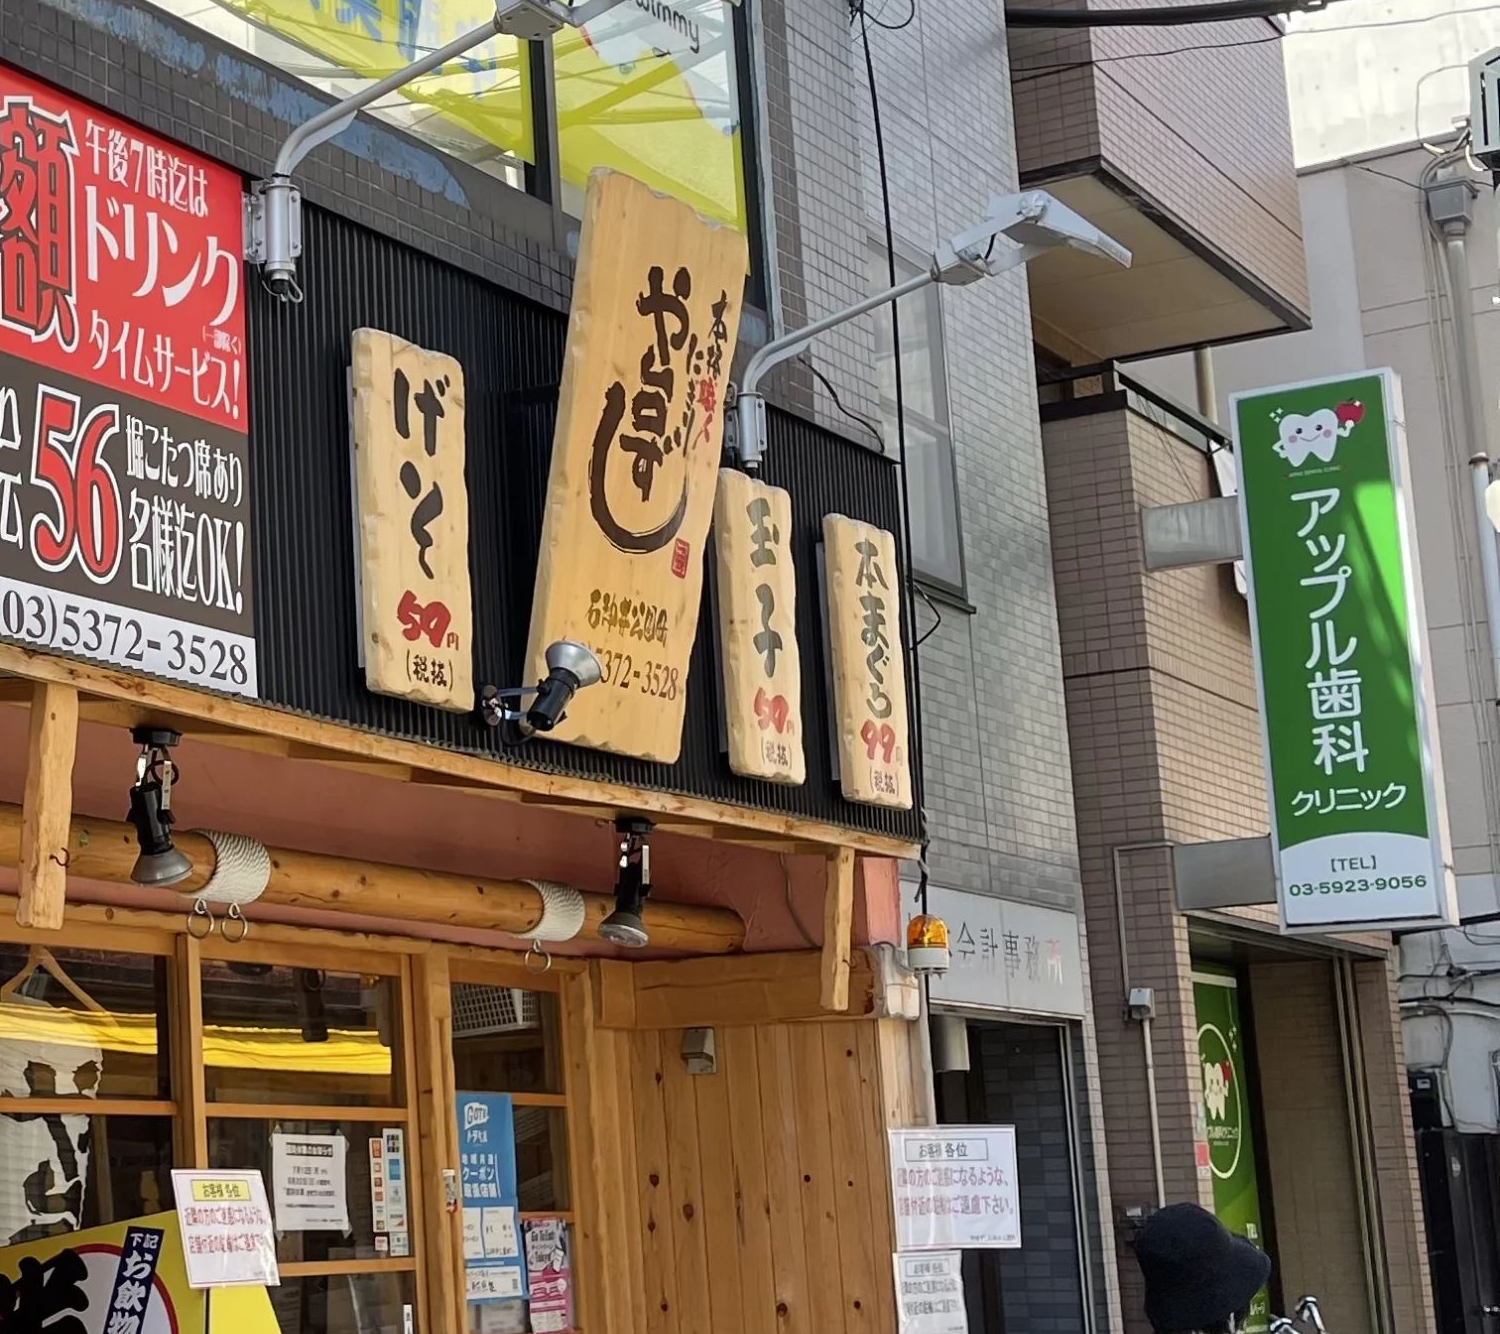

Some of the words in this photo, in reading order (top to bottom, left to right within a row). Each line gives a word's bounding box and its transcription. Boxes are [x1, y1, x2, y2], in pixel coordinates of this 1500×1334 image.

[85, 119, 209, 219] 午後7時迄は
[86, 185, 238, 326] ドリンク
[30, 383, 124, 585] 56
[393, 367, 444, 580] げそ
[746, 497, 784, 679] 玉子
[854, 538, 894, 720] 本まぐろ
[1290, 485, 1369, 777] アップル歯科
[1288, 874, 1428, 898] 03-5923-9056
[1290, 781, 1408, 818] クリニック
